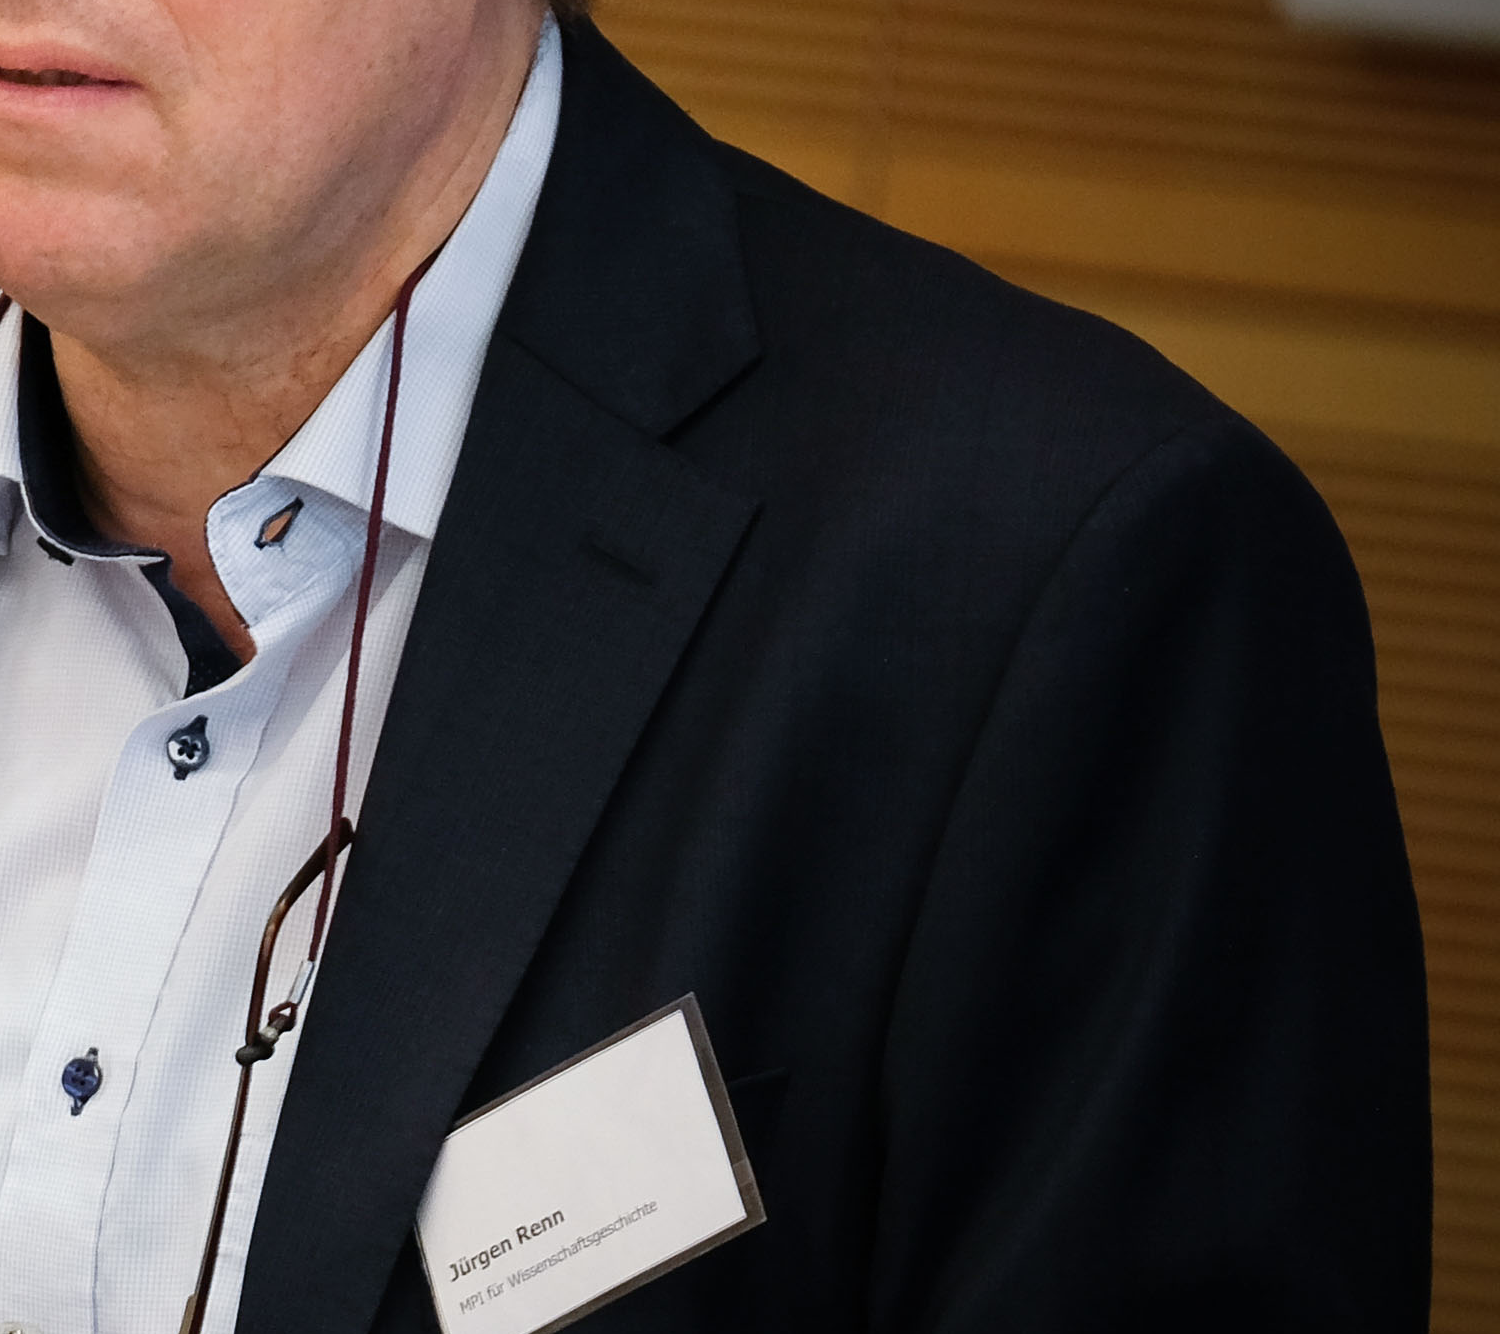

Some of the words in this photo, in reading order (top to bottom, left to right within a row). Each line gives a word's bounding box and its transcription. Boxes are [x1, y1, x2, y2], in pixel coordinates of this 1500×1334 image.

[449, 1236, 513, 1283] Jürgen
[515, 1209, 566, 1245] Renn
[459, 1291, 485, 1315] MPI
[486, 1281, 505, 1301] für
[506, 1199, 660, 1289] Wissenschaftsgeschichte
